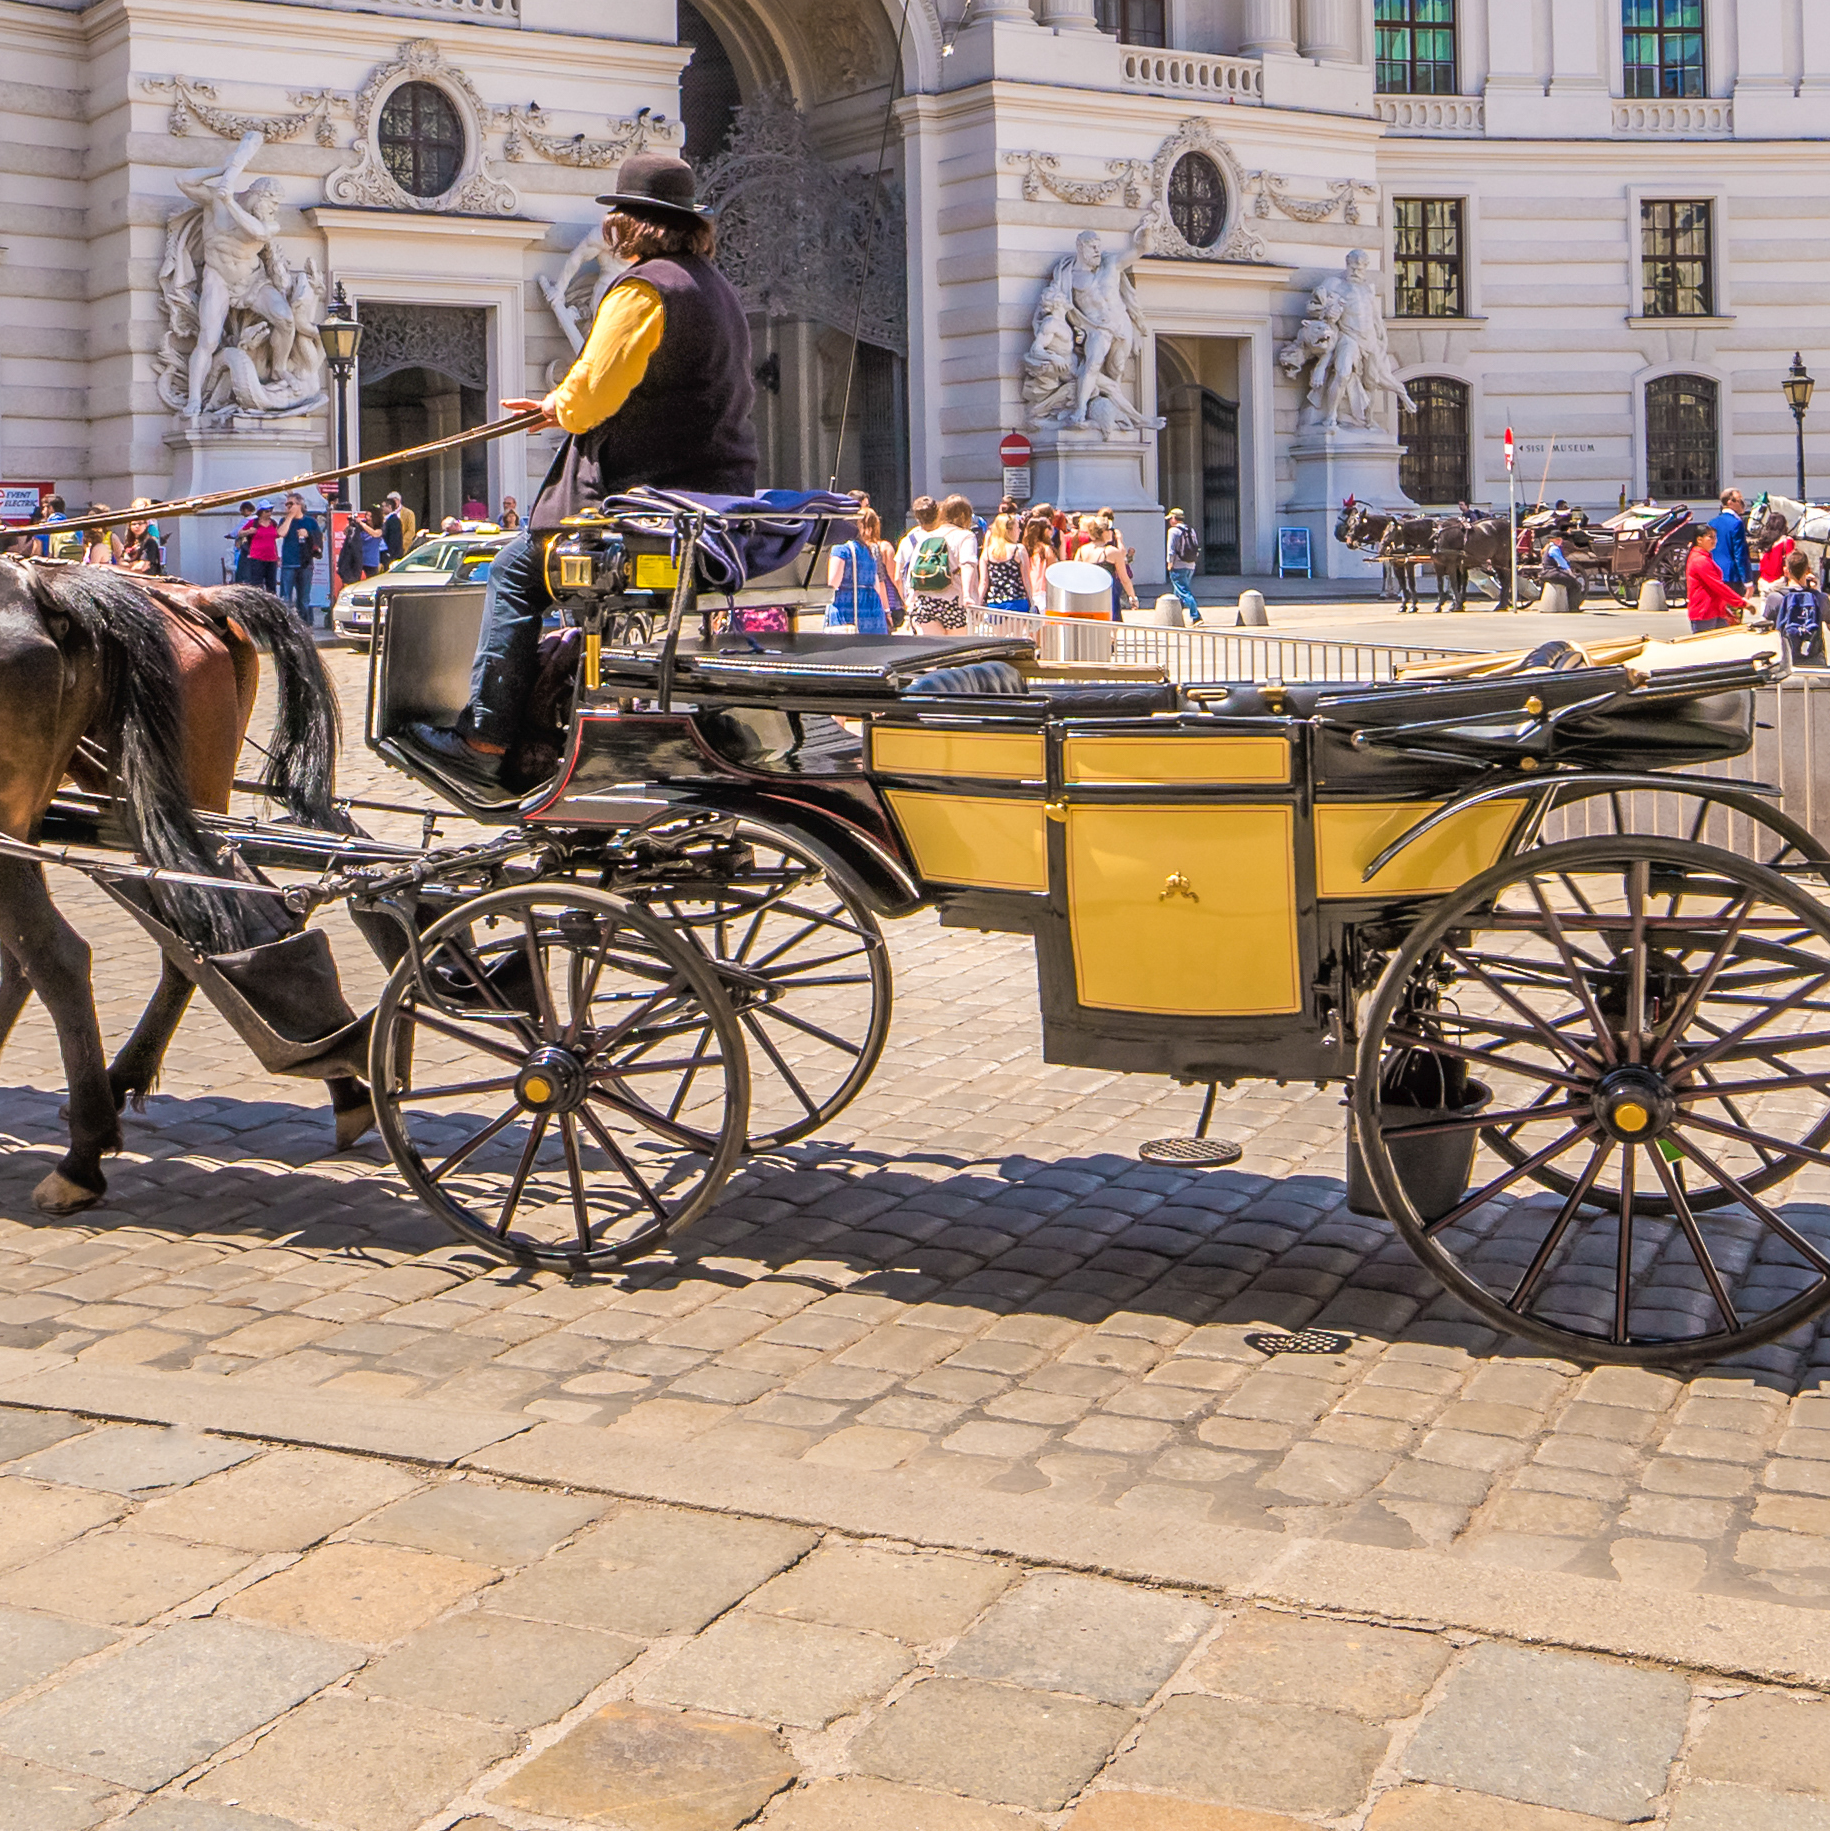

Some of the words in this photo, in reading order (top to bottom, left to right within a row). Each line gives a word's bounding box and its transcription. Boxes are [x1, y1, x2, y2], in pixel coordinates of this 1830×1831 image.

[1526, 444, 1545, 453] SISI
[1552, 443, 1595, 452] MUSEUM
[6, 491, 32, 499] EVENT
[4, 499, 38, 507] ELECTRIC
